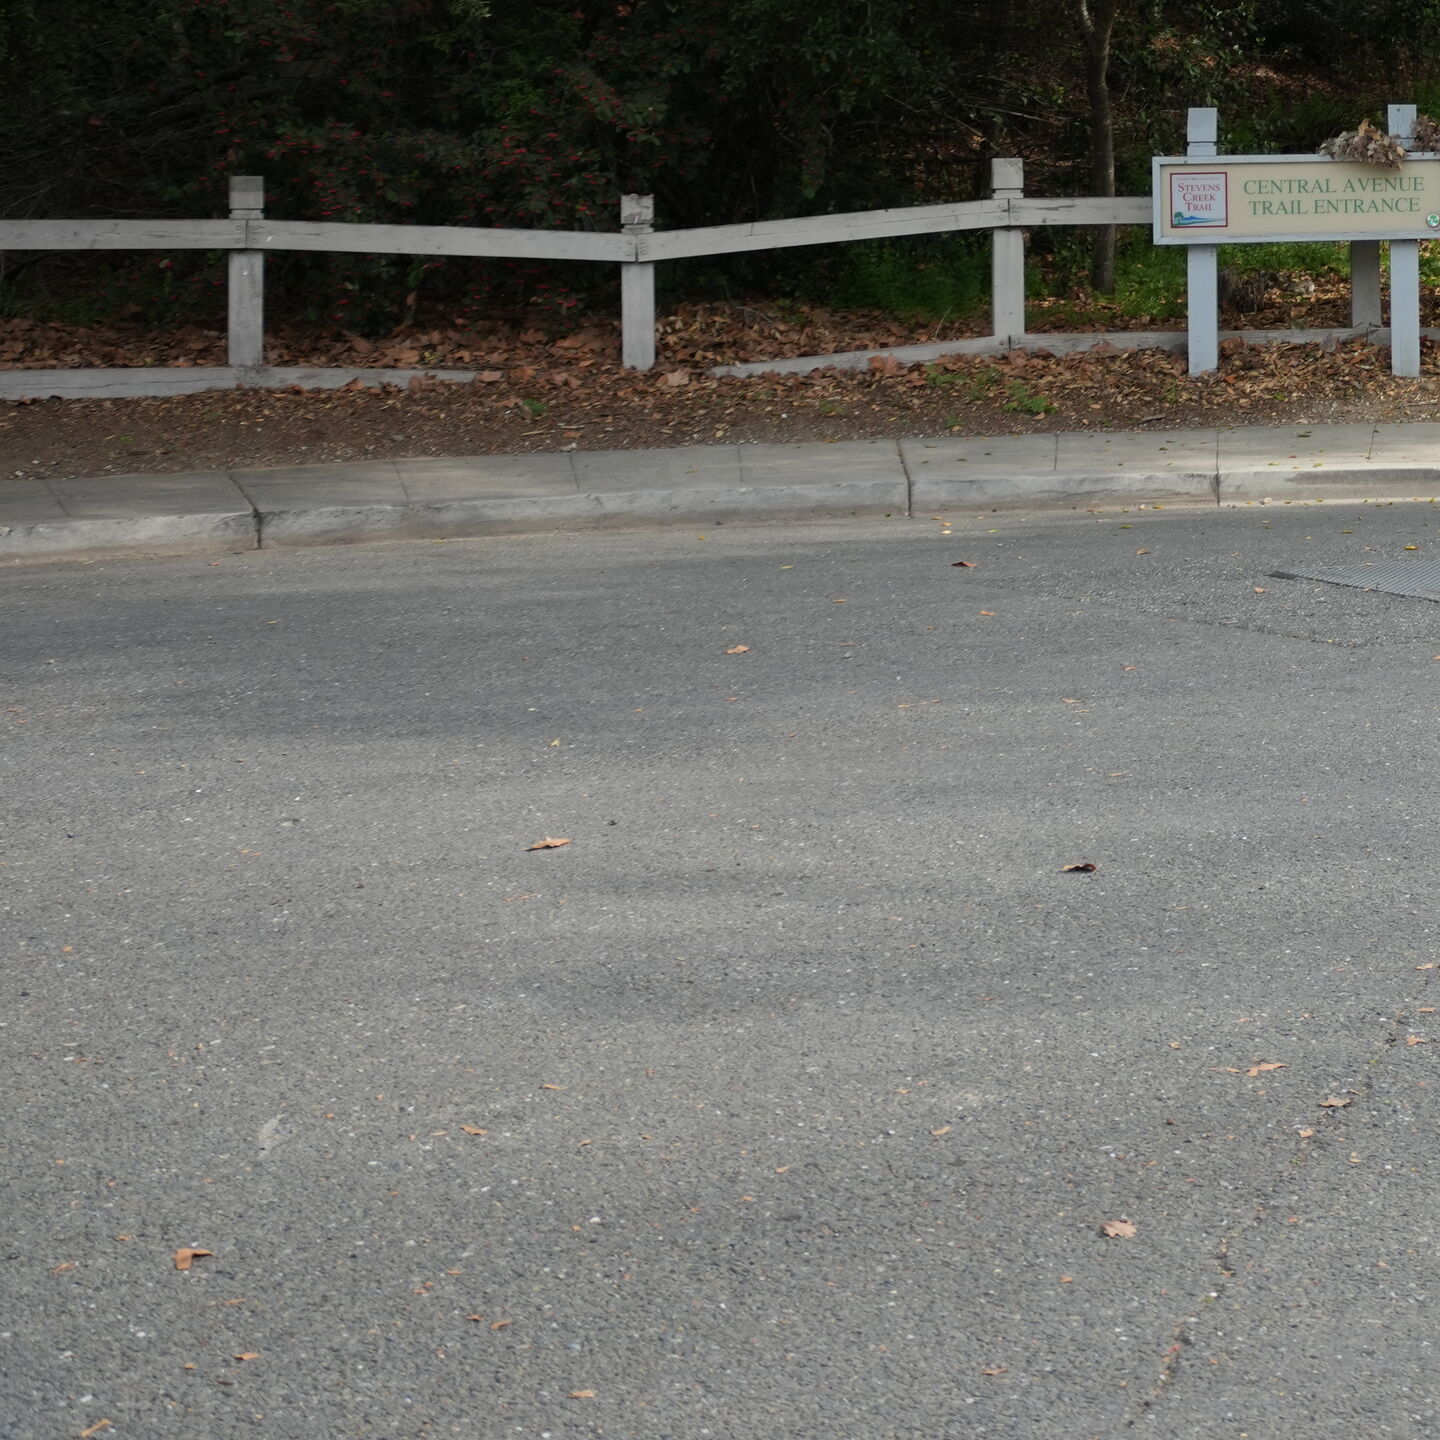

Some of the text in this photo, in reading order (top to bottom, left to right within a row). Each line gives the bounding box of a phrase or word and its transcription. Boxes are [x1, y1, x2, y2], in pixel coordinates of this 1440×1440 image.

[1178, 183, 1220, 192] STEVENS
[1243, 176, 1425, 195] CENTRAL AVENUE
[1183, 192, 1216, 202] CREEK
[1185, 202, 1214, 212] TRAIL
[1249, 197, 1421, 216] TRAIL ENTRANCE
